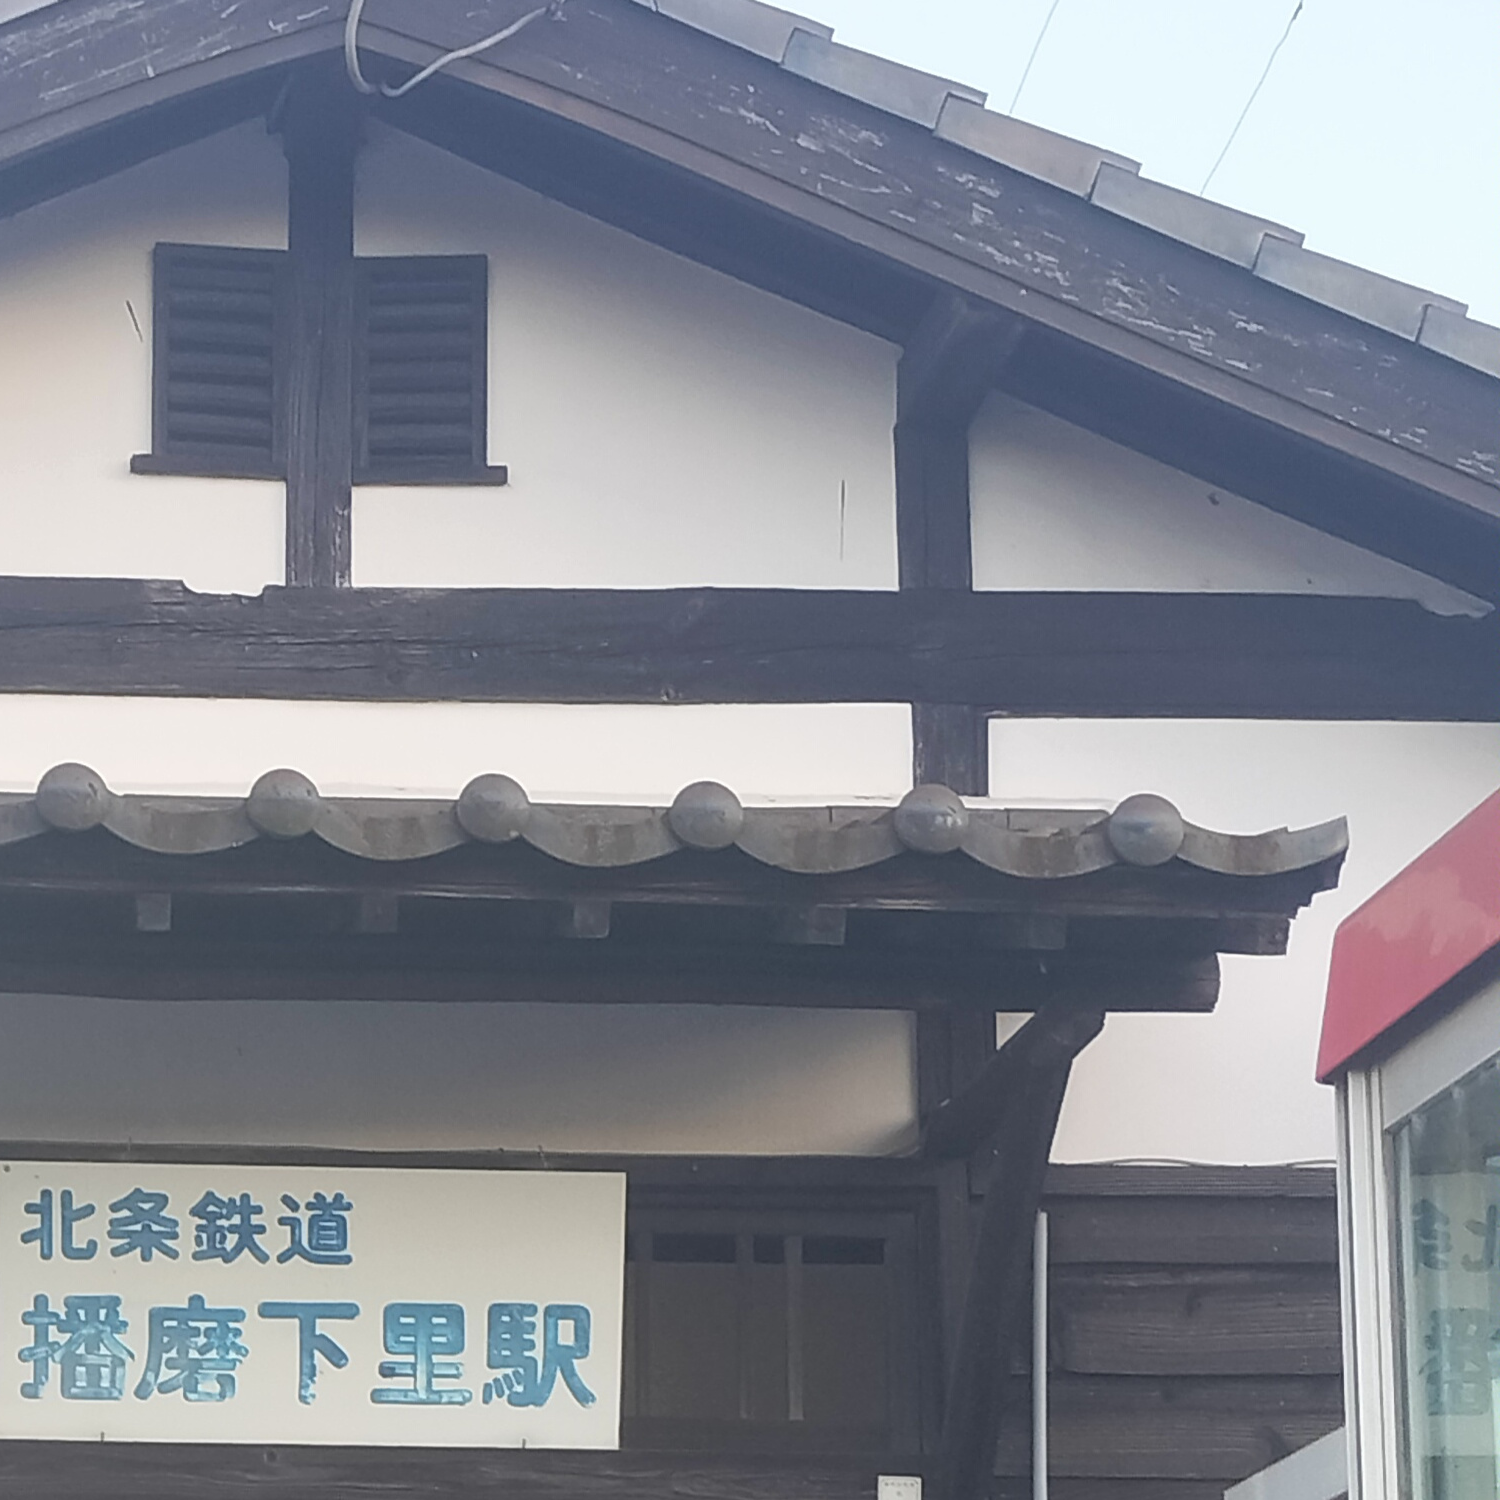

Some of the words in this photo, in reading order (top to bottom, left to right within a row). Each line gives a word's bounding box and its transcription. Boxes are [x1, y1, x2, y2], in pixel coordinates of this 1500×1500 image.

[20, 1187, 354, 1265] 北条鉄道
[18, 1294, 596, 1407] 播磨下里駅
